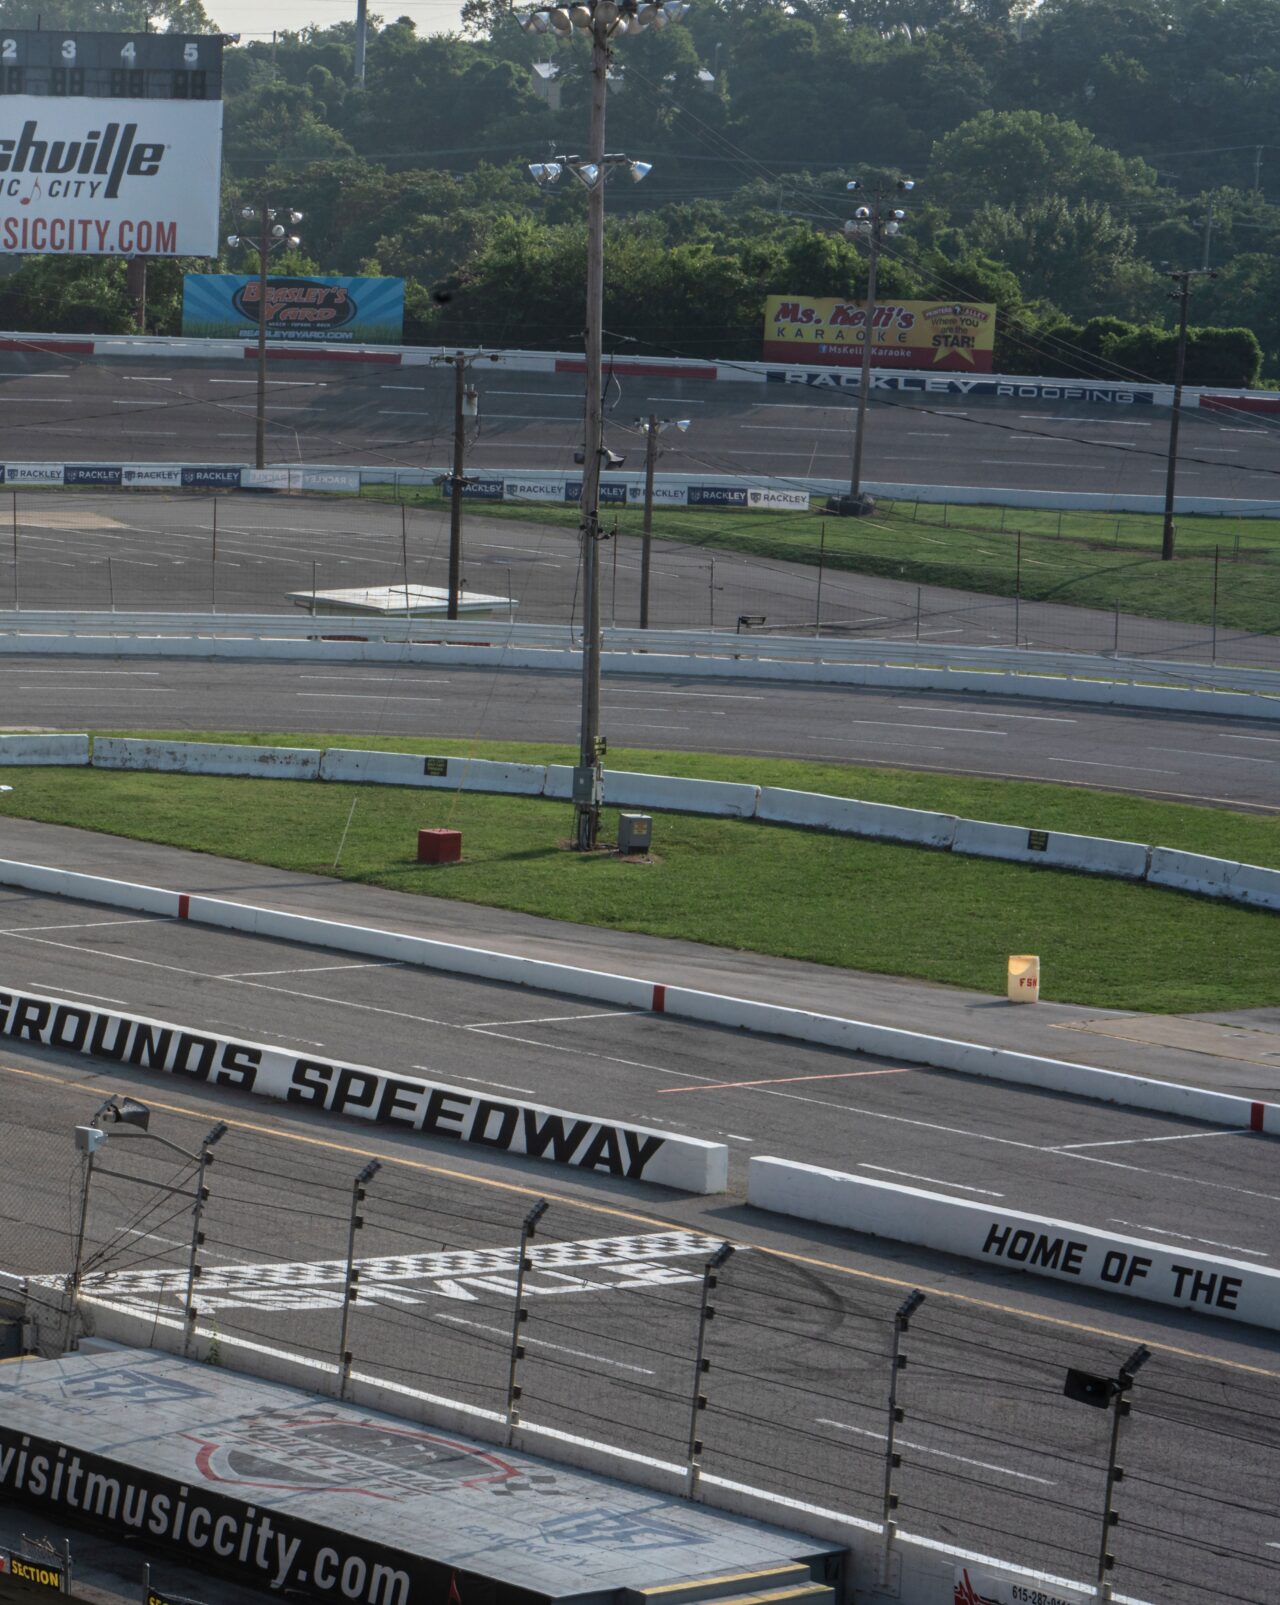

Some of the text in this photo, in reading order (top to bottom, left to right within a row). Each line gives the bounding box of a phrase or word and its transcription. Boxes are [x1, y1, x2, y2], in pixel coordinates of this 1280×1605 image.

[2, 39, 17, 58] 2
[61, 40, 76, 59] 3
[121, 41, 136, 59] 4
[184, 43, 198, 62] 5
[48, 180, 102, 199] CITY
[264, 303, 336, 321] YARD
[774, 302, 914, 329] Ms. Keli's
[960, 318, 979, 328] YOU
[239, 329, 353, 340] BEALEYSYARD.COM
[777, 328, 908, 342] KARAOKE
[932, 334, 975, 348] STAR!
[829, 345, 912, 357] MsKellKaraoke
[785, 371, 1135, 404] RACKLEY ROOFING
[20, 470, 61, 479] RACKLEY
[78, 470, 120, 479] RACKLEY
[137, 471, 178, 480] RACKLEY
[196, 471, 239, 481] RACKLEY
[461, 484, 502, 493] ACKLEY
[519, 485, 563, 494] RACKLEY
[703, 490, 746, 501] RACKLEY
[763, 493, 807, 504] RACKLEY
[1019, 977, 1037, 988] FSN
[288, 1057, 665, 1180] SPEEDWAY
[982, 1223, 1243, 1311] HOME OF THE
[11, 1558, 60, 1589] SECTION
[1012, 1585, 1072, 1605] 615-287-0
